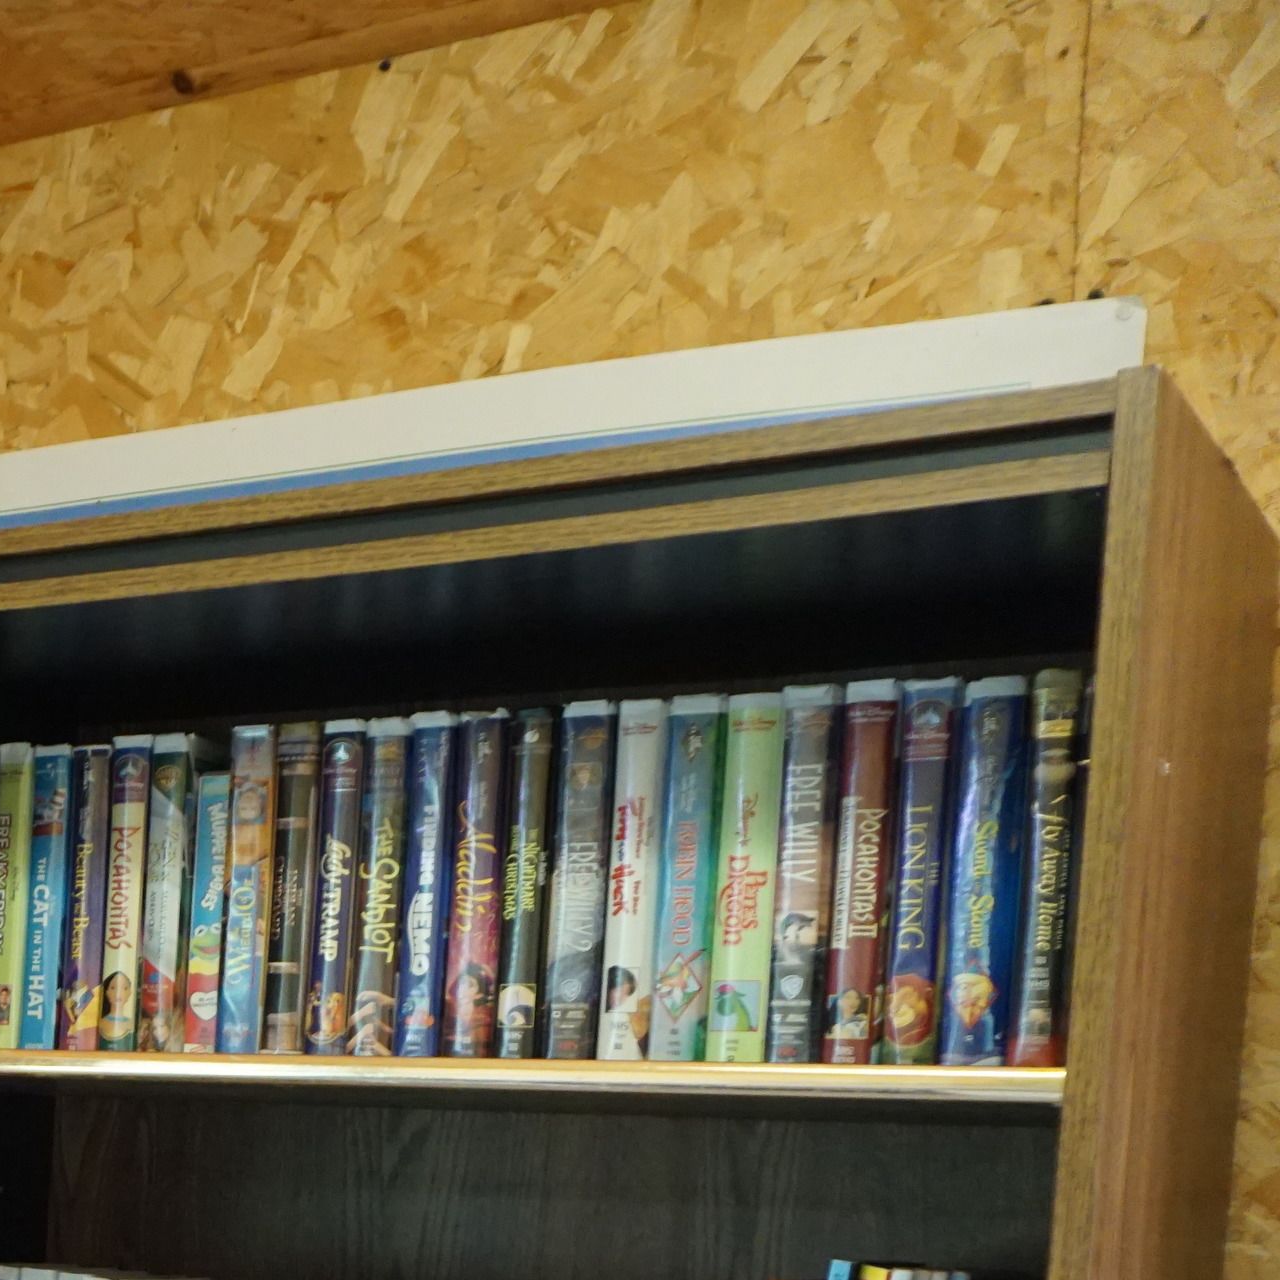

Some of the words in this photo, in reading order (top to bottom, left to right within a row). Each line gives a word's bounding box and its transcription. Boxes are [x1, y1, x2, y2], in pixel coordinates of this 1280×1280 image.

[787, 763, 824, 814] FREE
[321, 834, 351, 884] Lady
[420, 804, 439, 884] FINDING
[781, 820, 819, 884] WILLY
[852, 808, 889, 922] POCAHONTAS
[901, 804, 934, 873] LION
[38, 857, 46, 882] THE
[104, 826, 142, 950] POCAHONTAS
[33, 883, 50, 927] CAT
[320, 884, 343, 962] TRAMP
[407, 890, 434, 977] NEMO
[849, 921, 878, 939] II
[898, 877, 931, 951] KING
[31, 947, 40, 972] THE
[34, 933, 42, 943] IN
[27, 975, 45, 1019] HAT
